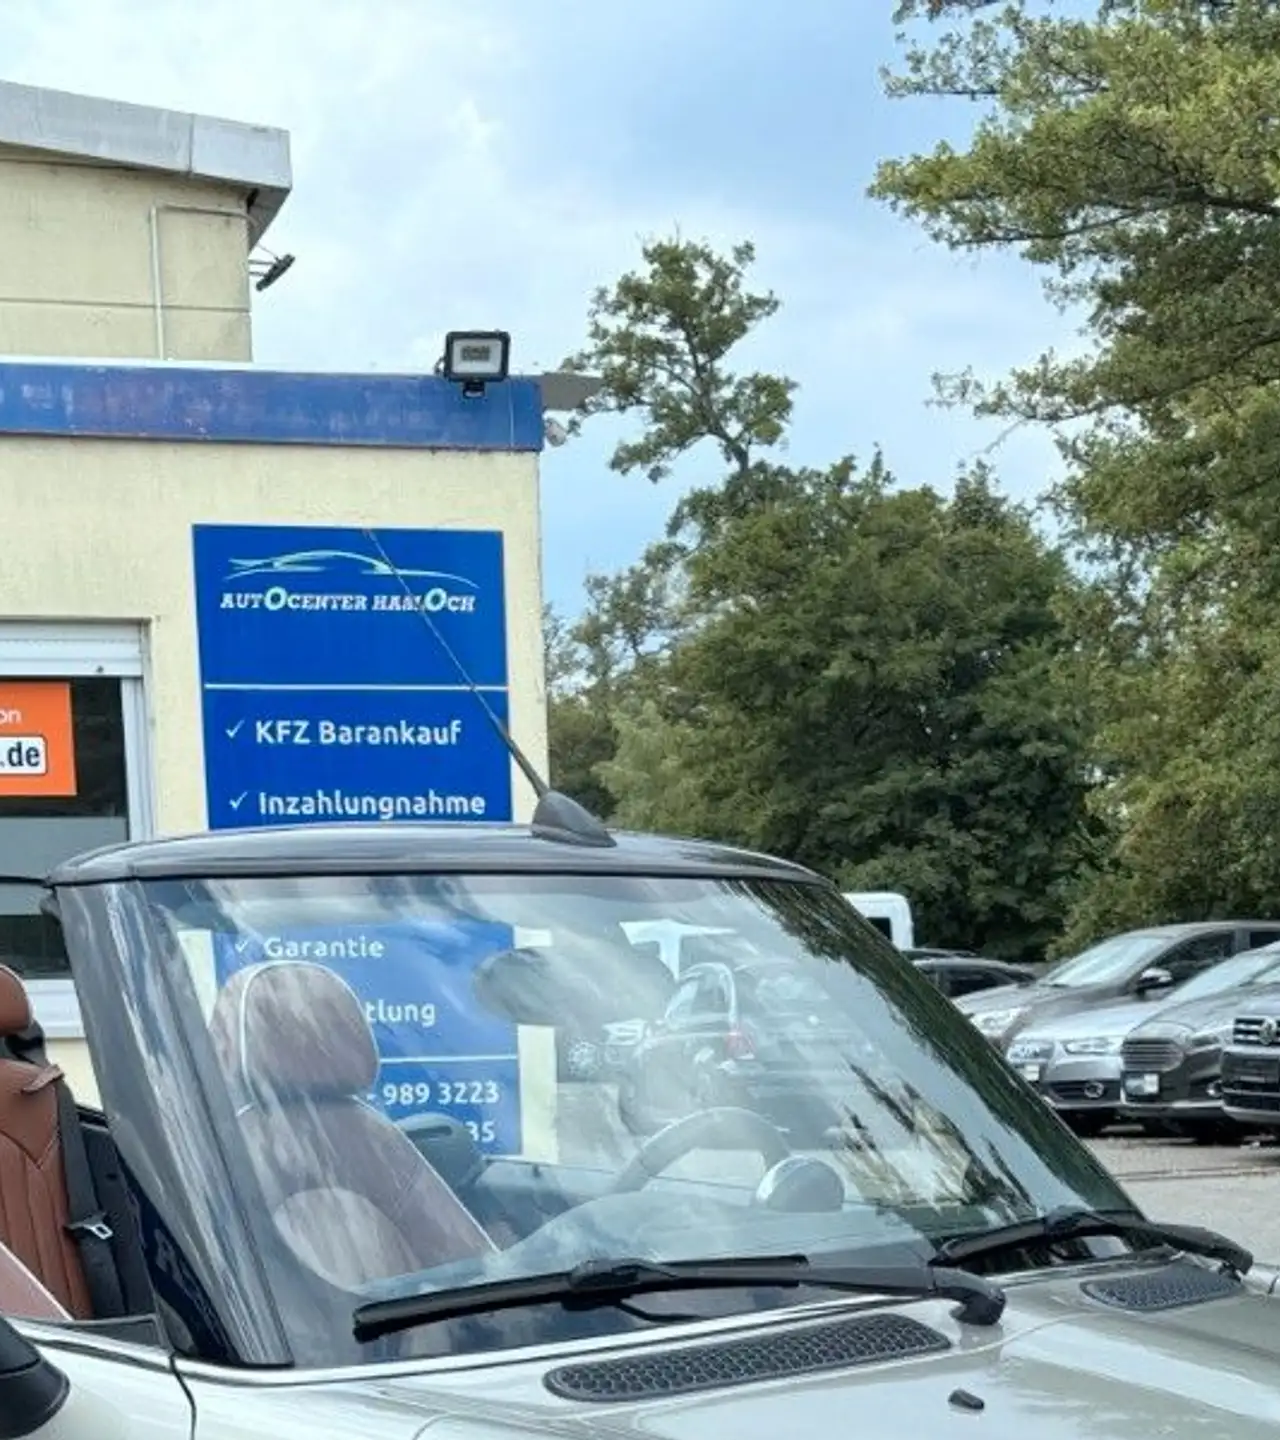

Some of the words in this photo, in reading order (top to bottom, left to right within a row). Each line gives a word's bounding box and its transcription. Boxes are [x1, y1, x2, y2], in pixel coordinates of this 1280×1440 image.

[220, 586, 368, 612] AUTOCENTER
[255, 720, 311, 745] KFZ
[319, 719, 462, 746] Barankauf
[259, 790, 486, 819] Inzahlungnahme
[263, 934, 385, 958] Garantie
[382, 1082, 430, 1106] 989
[437, 1080, 499, 1105] 3223
